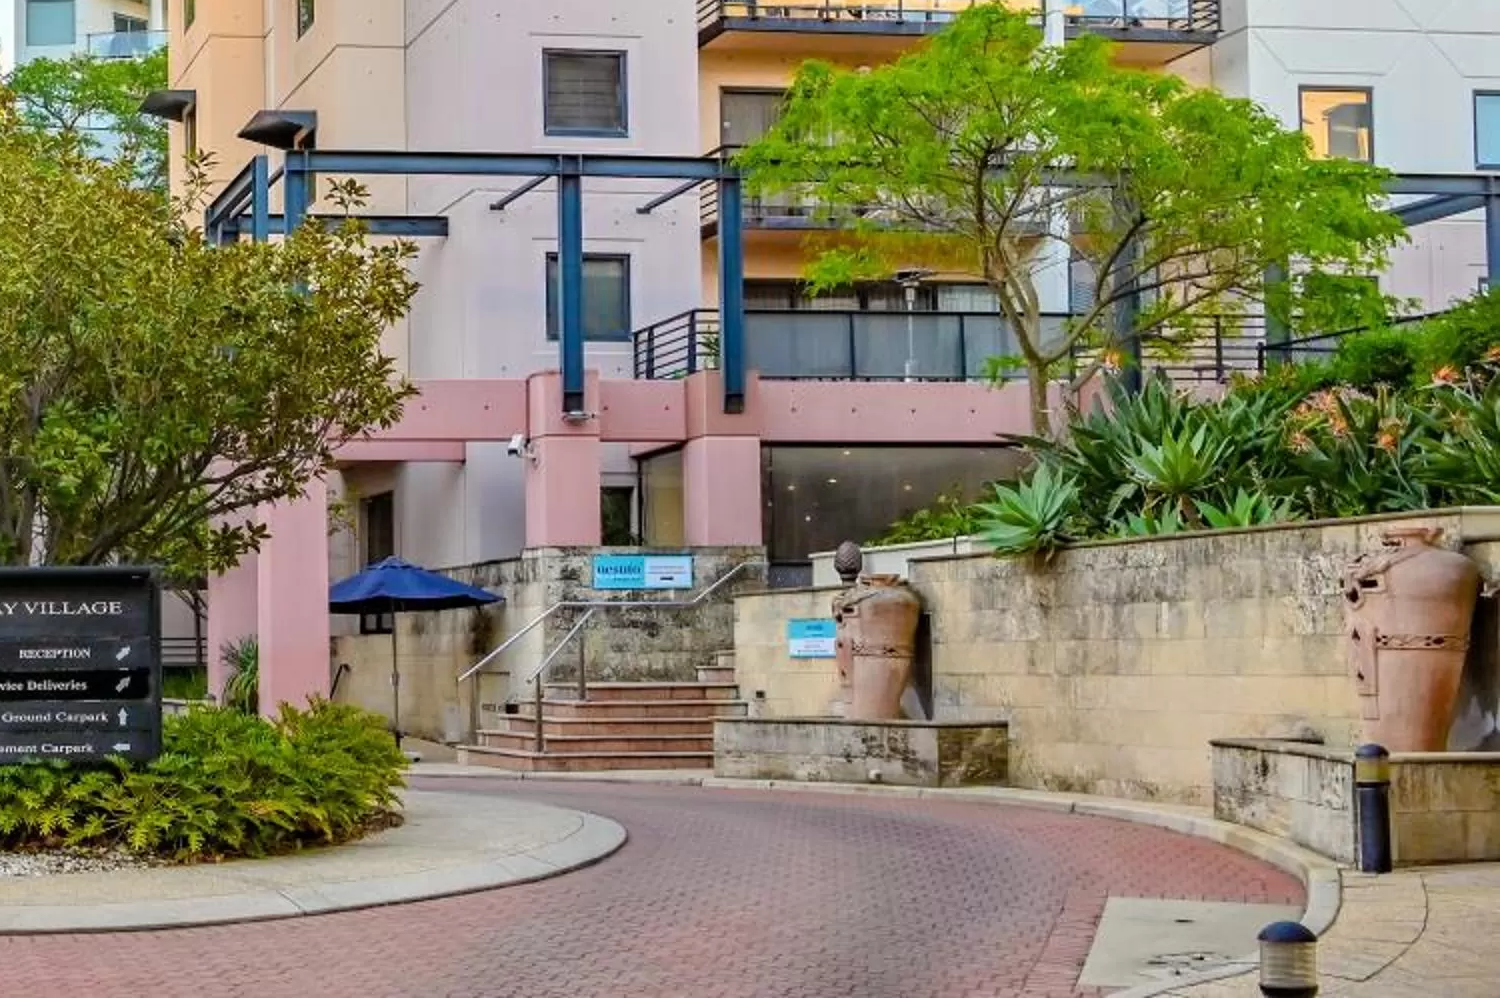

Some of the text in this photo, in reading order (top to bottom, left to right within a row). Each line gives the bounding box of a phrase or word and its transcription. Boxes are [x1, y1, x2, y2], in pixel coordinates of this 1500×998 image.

[25, 601, 123, 615] VILLAGE
[19, 648, 91, 659] RECEPTION
[27, 679, 88, 691] Deliveries
[1, 711, 51, 724] Ground
[55, 711, 109, 724] Carpark
[41, 743, 95, 755] Carpark
